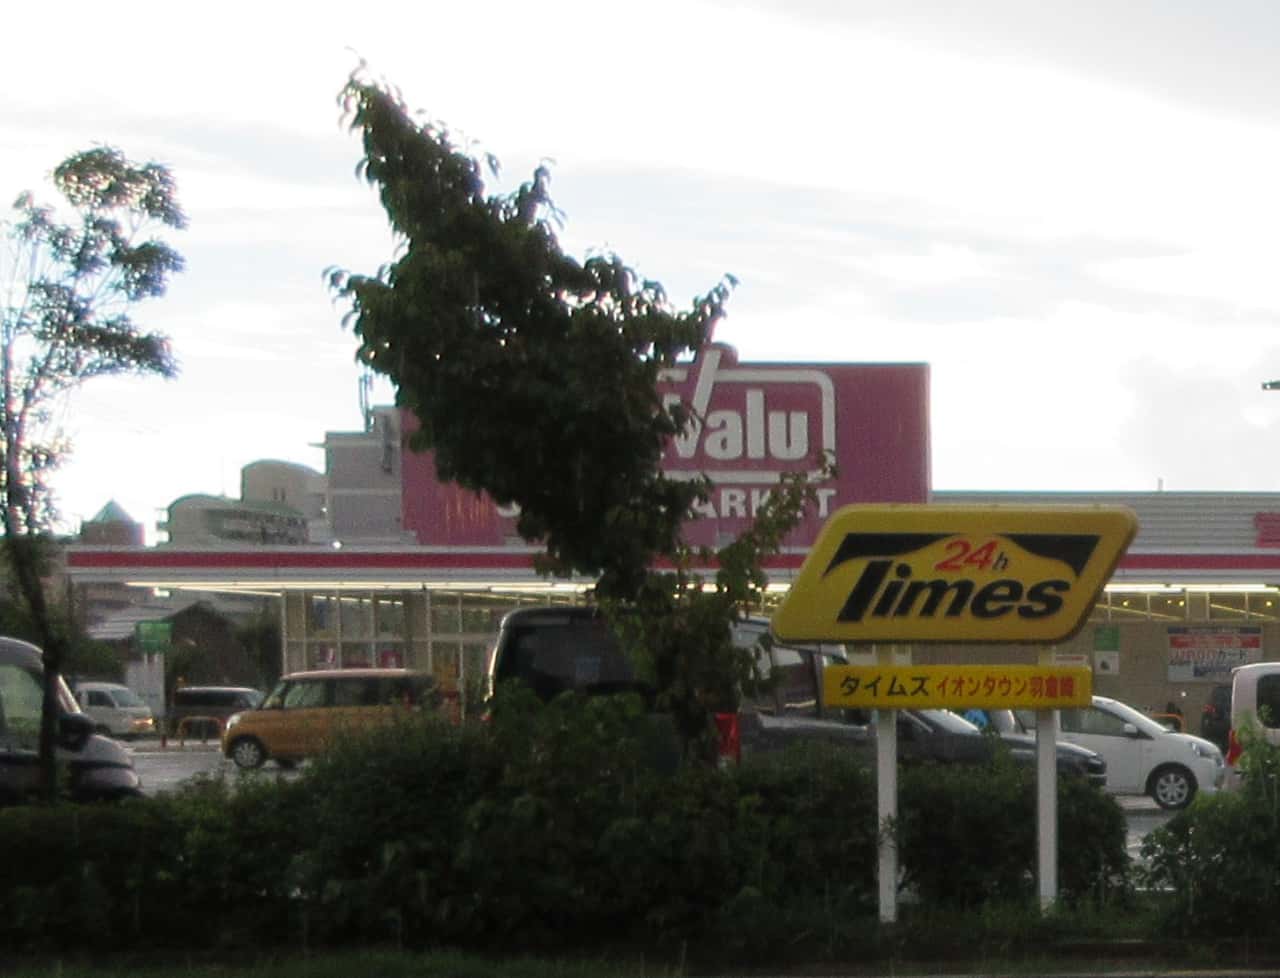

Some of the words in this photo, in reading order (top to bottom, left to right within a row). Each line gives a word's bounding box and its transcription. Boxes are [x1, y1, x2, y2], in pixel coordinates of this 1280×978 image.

[837, 559, 1071, 624] Times
[840, 675, 930, 699] タイムズ
